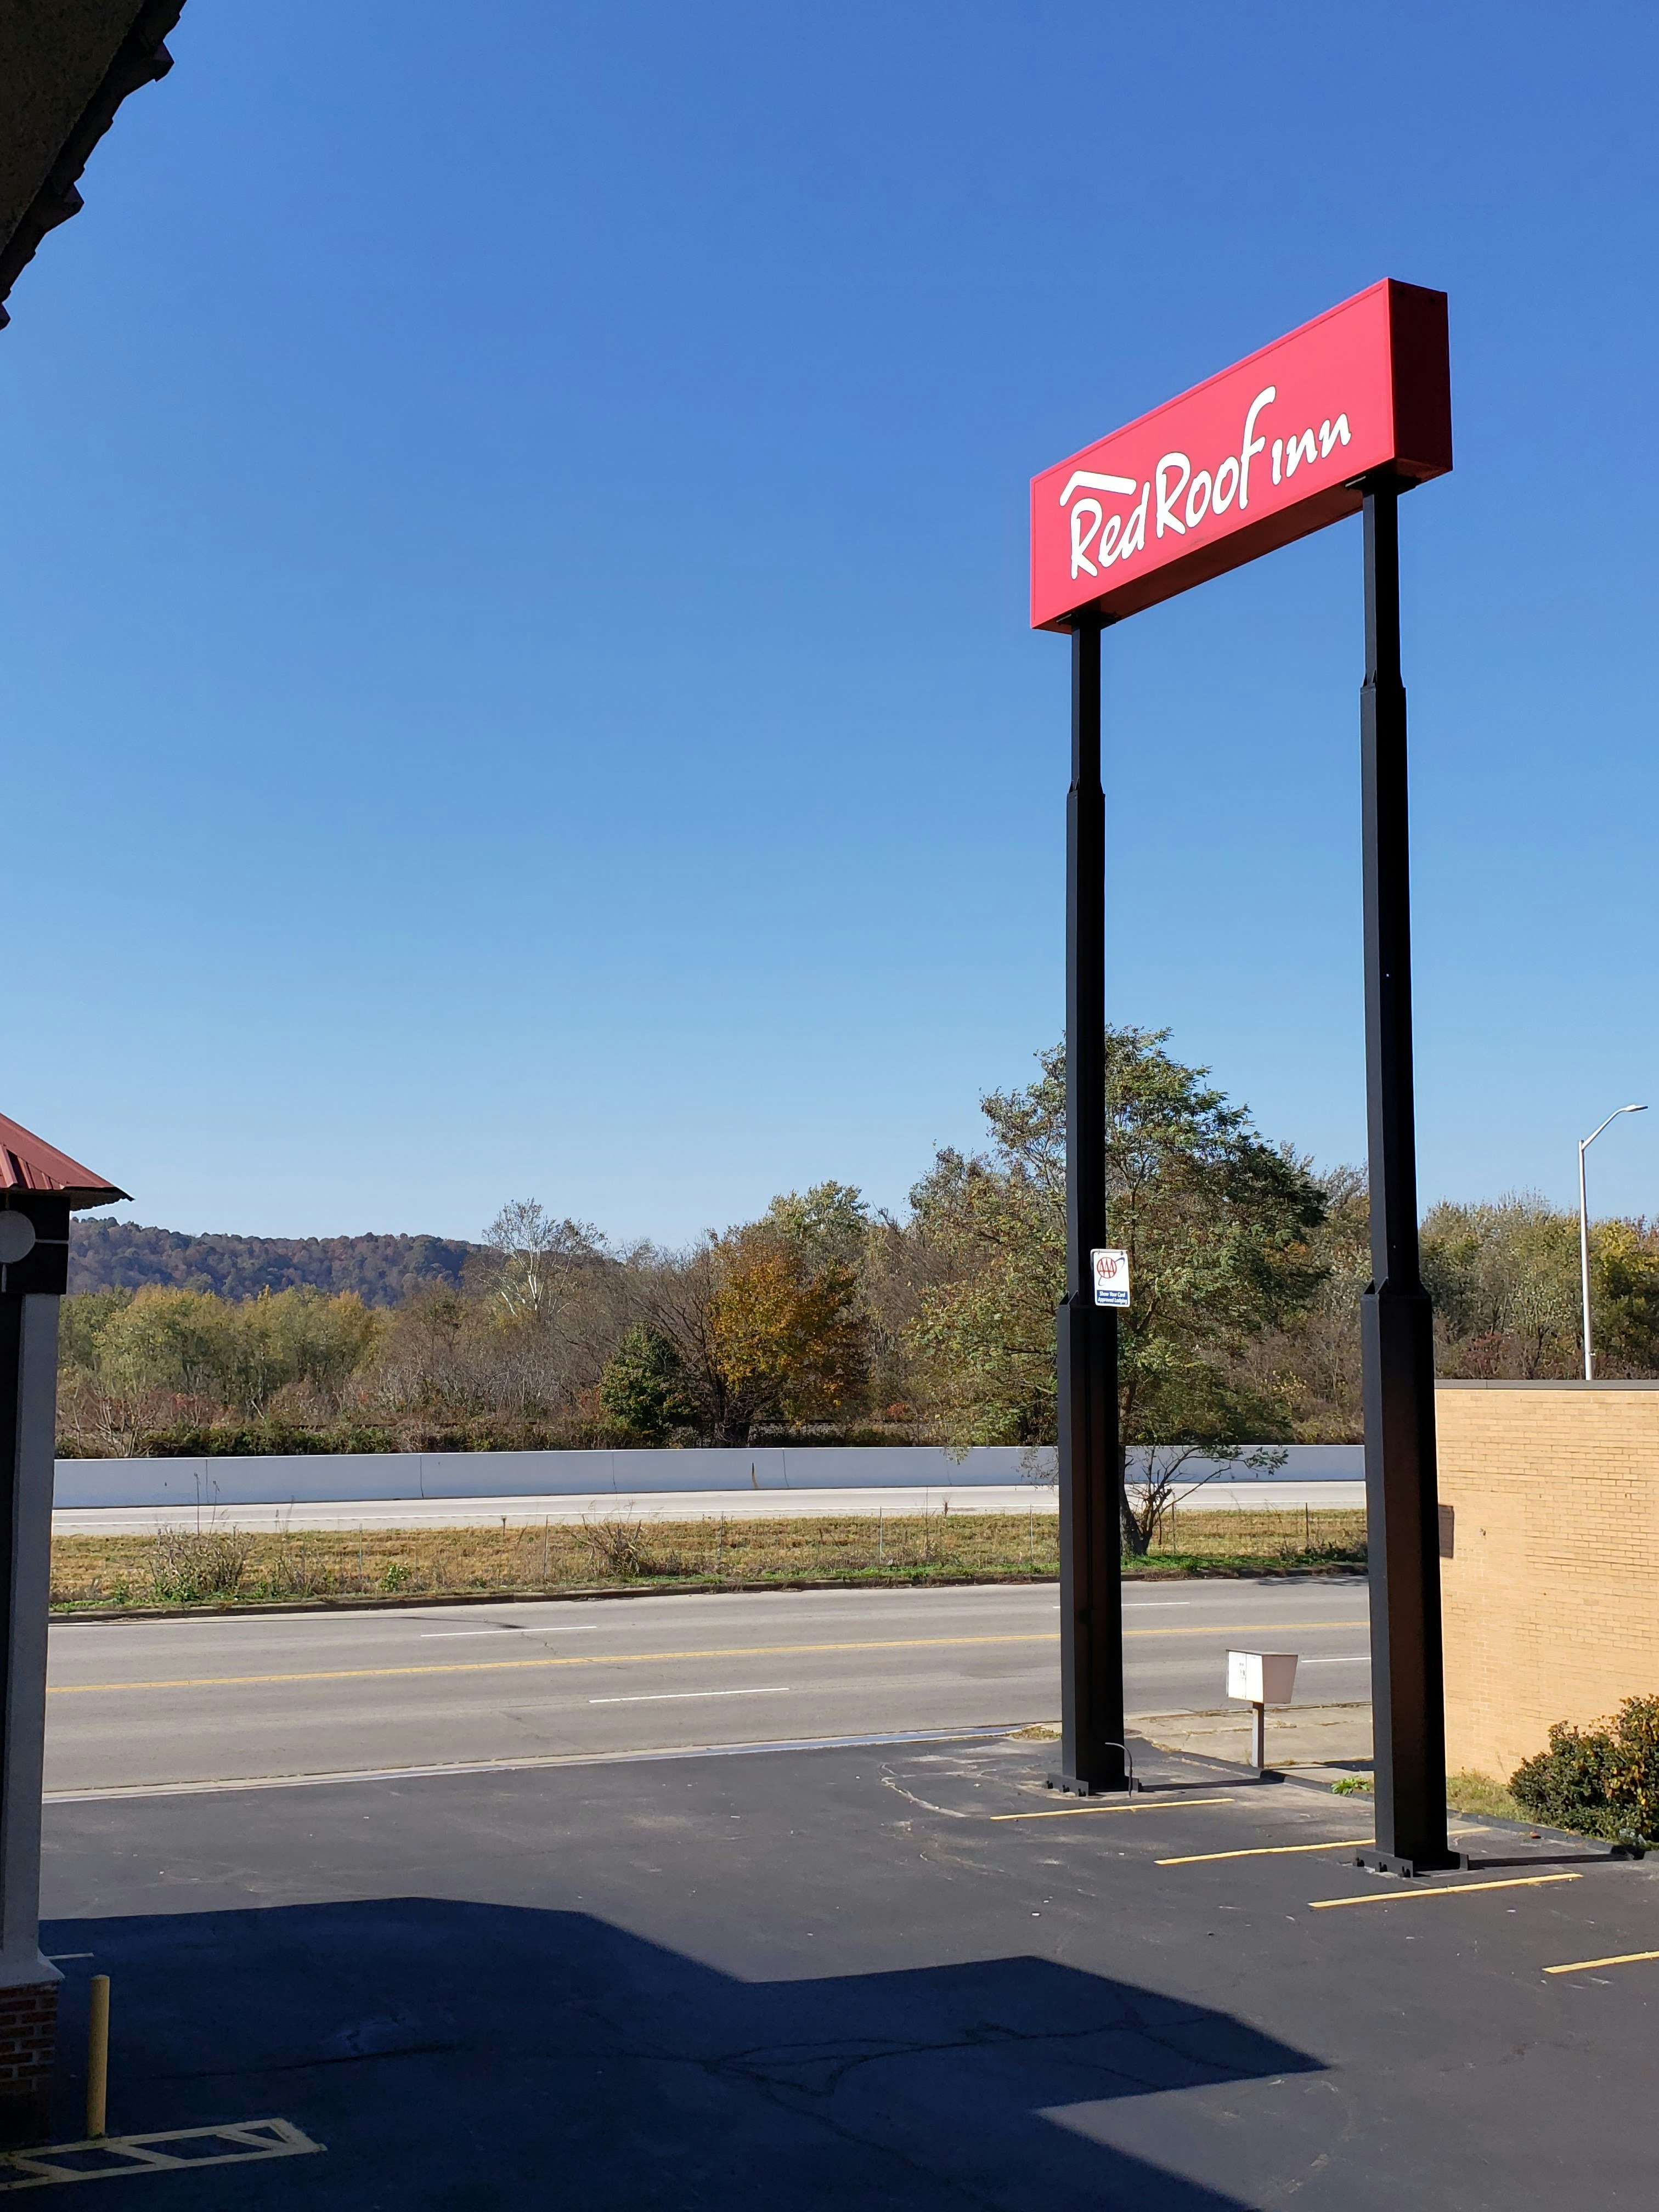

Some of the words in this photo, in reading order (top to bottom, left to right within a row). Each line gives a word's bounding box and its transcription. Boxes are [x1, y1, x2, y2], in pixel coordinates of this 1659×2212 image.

[1070, 481, 1151, 580] Red
[1155, 386, 1276, 539] Roof
[1271, 413, 1352, 486] inn
[1098, 1257, 1115, 1278] AAA
